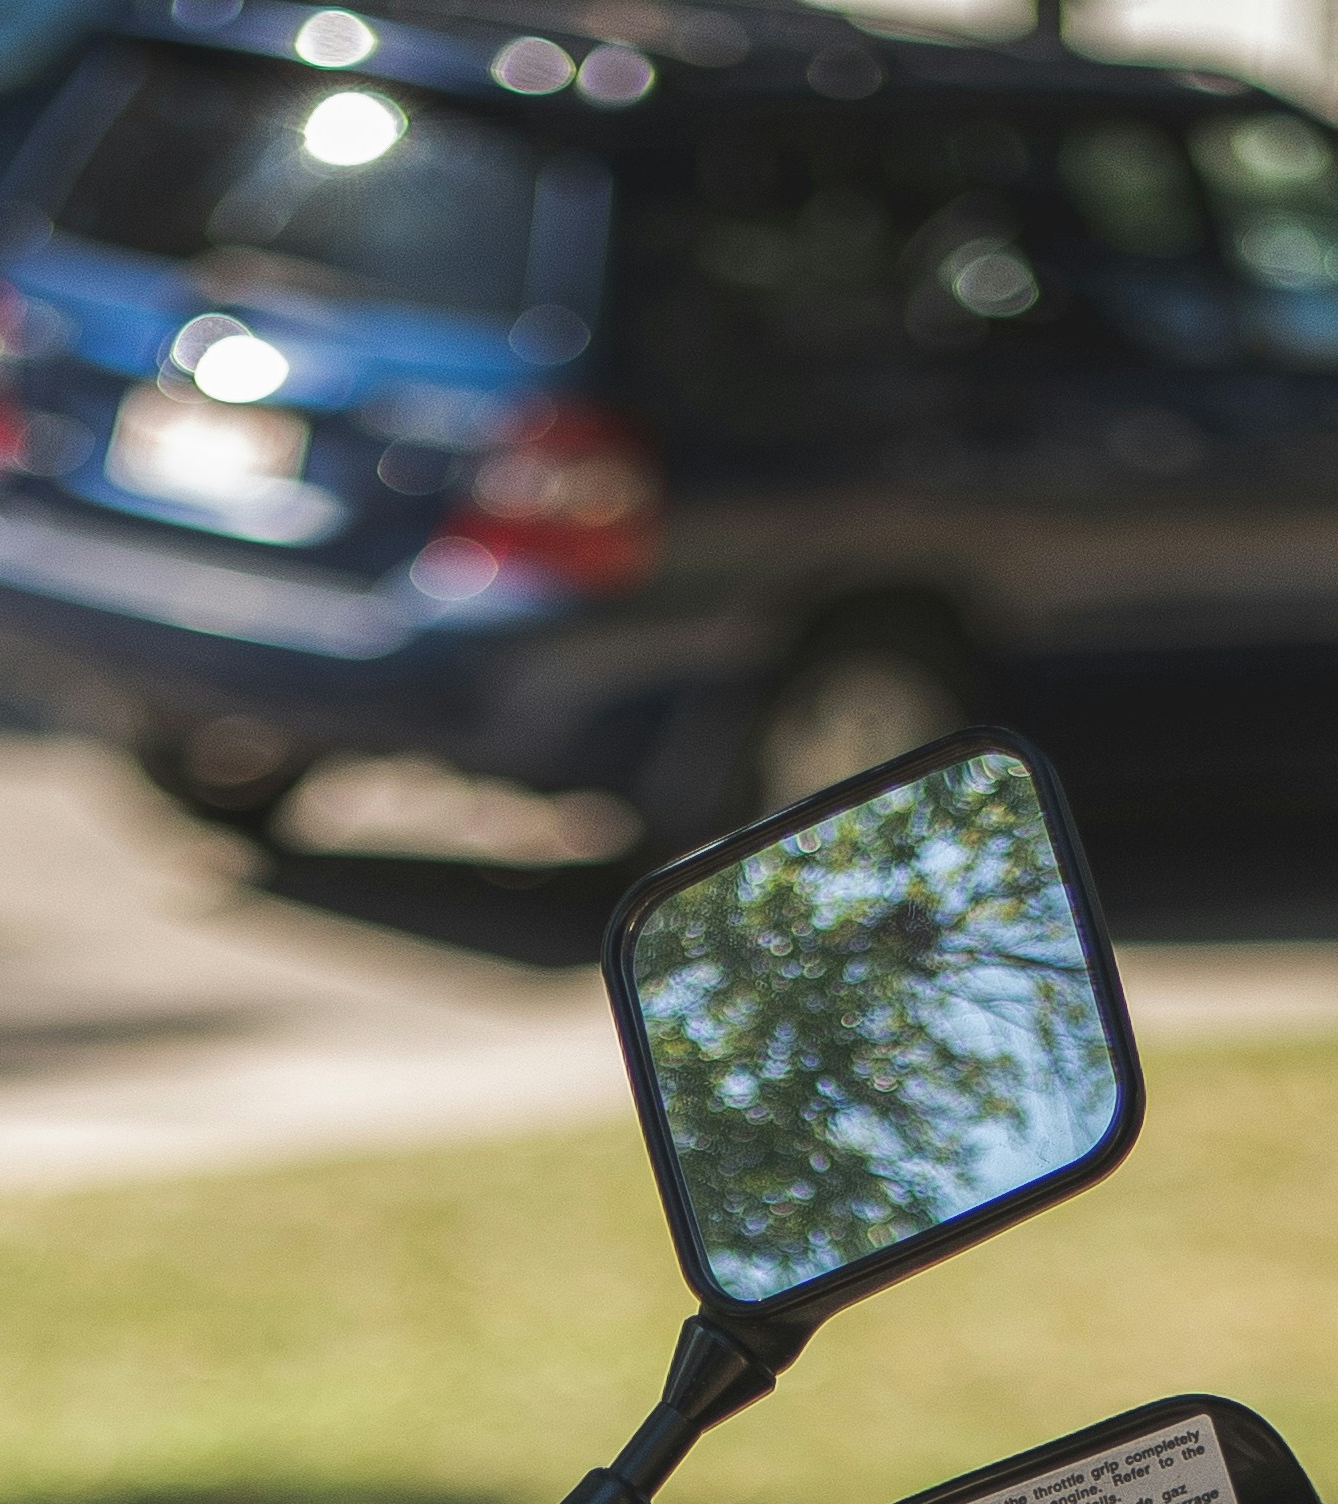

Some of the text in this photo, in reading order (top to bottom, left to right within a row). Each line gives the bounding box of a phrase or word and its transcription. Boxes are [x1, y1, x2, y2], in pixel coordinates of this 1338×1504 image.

[1033, 1473, 1085, 1500] throttle
[1091, 1461, 1119, 1481] grip
[1125, 1430, 1200, 1466] completely
[1112, 1464, 1150, 1487] Refer
[1158, 1457, 1174, 1469] to
[1181, 1445, 1205, 1460] the
[1162, 1484, 1188, 1504] gaz
